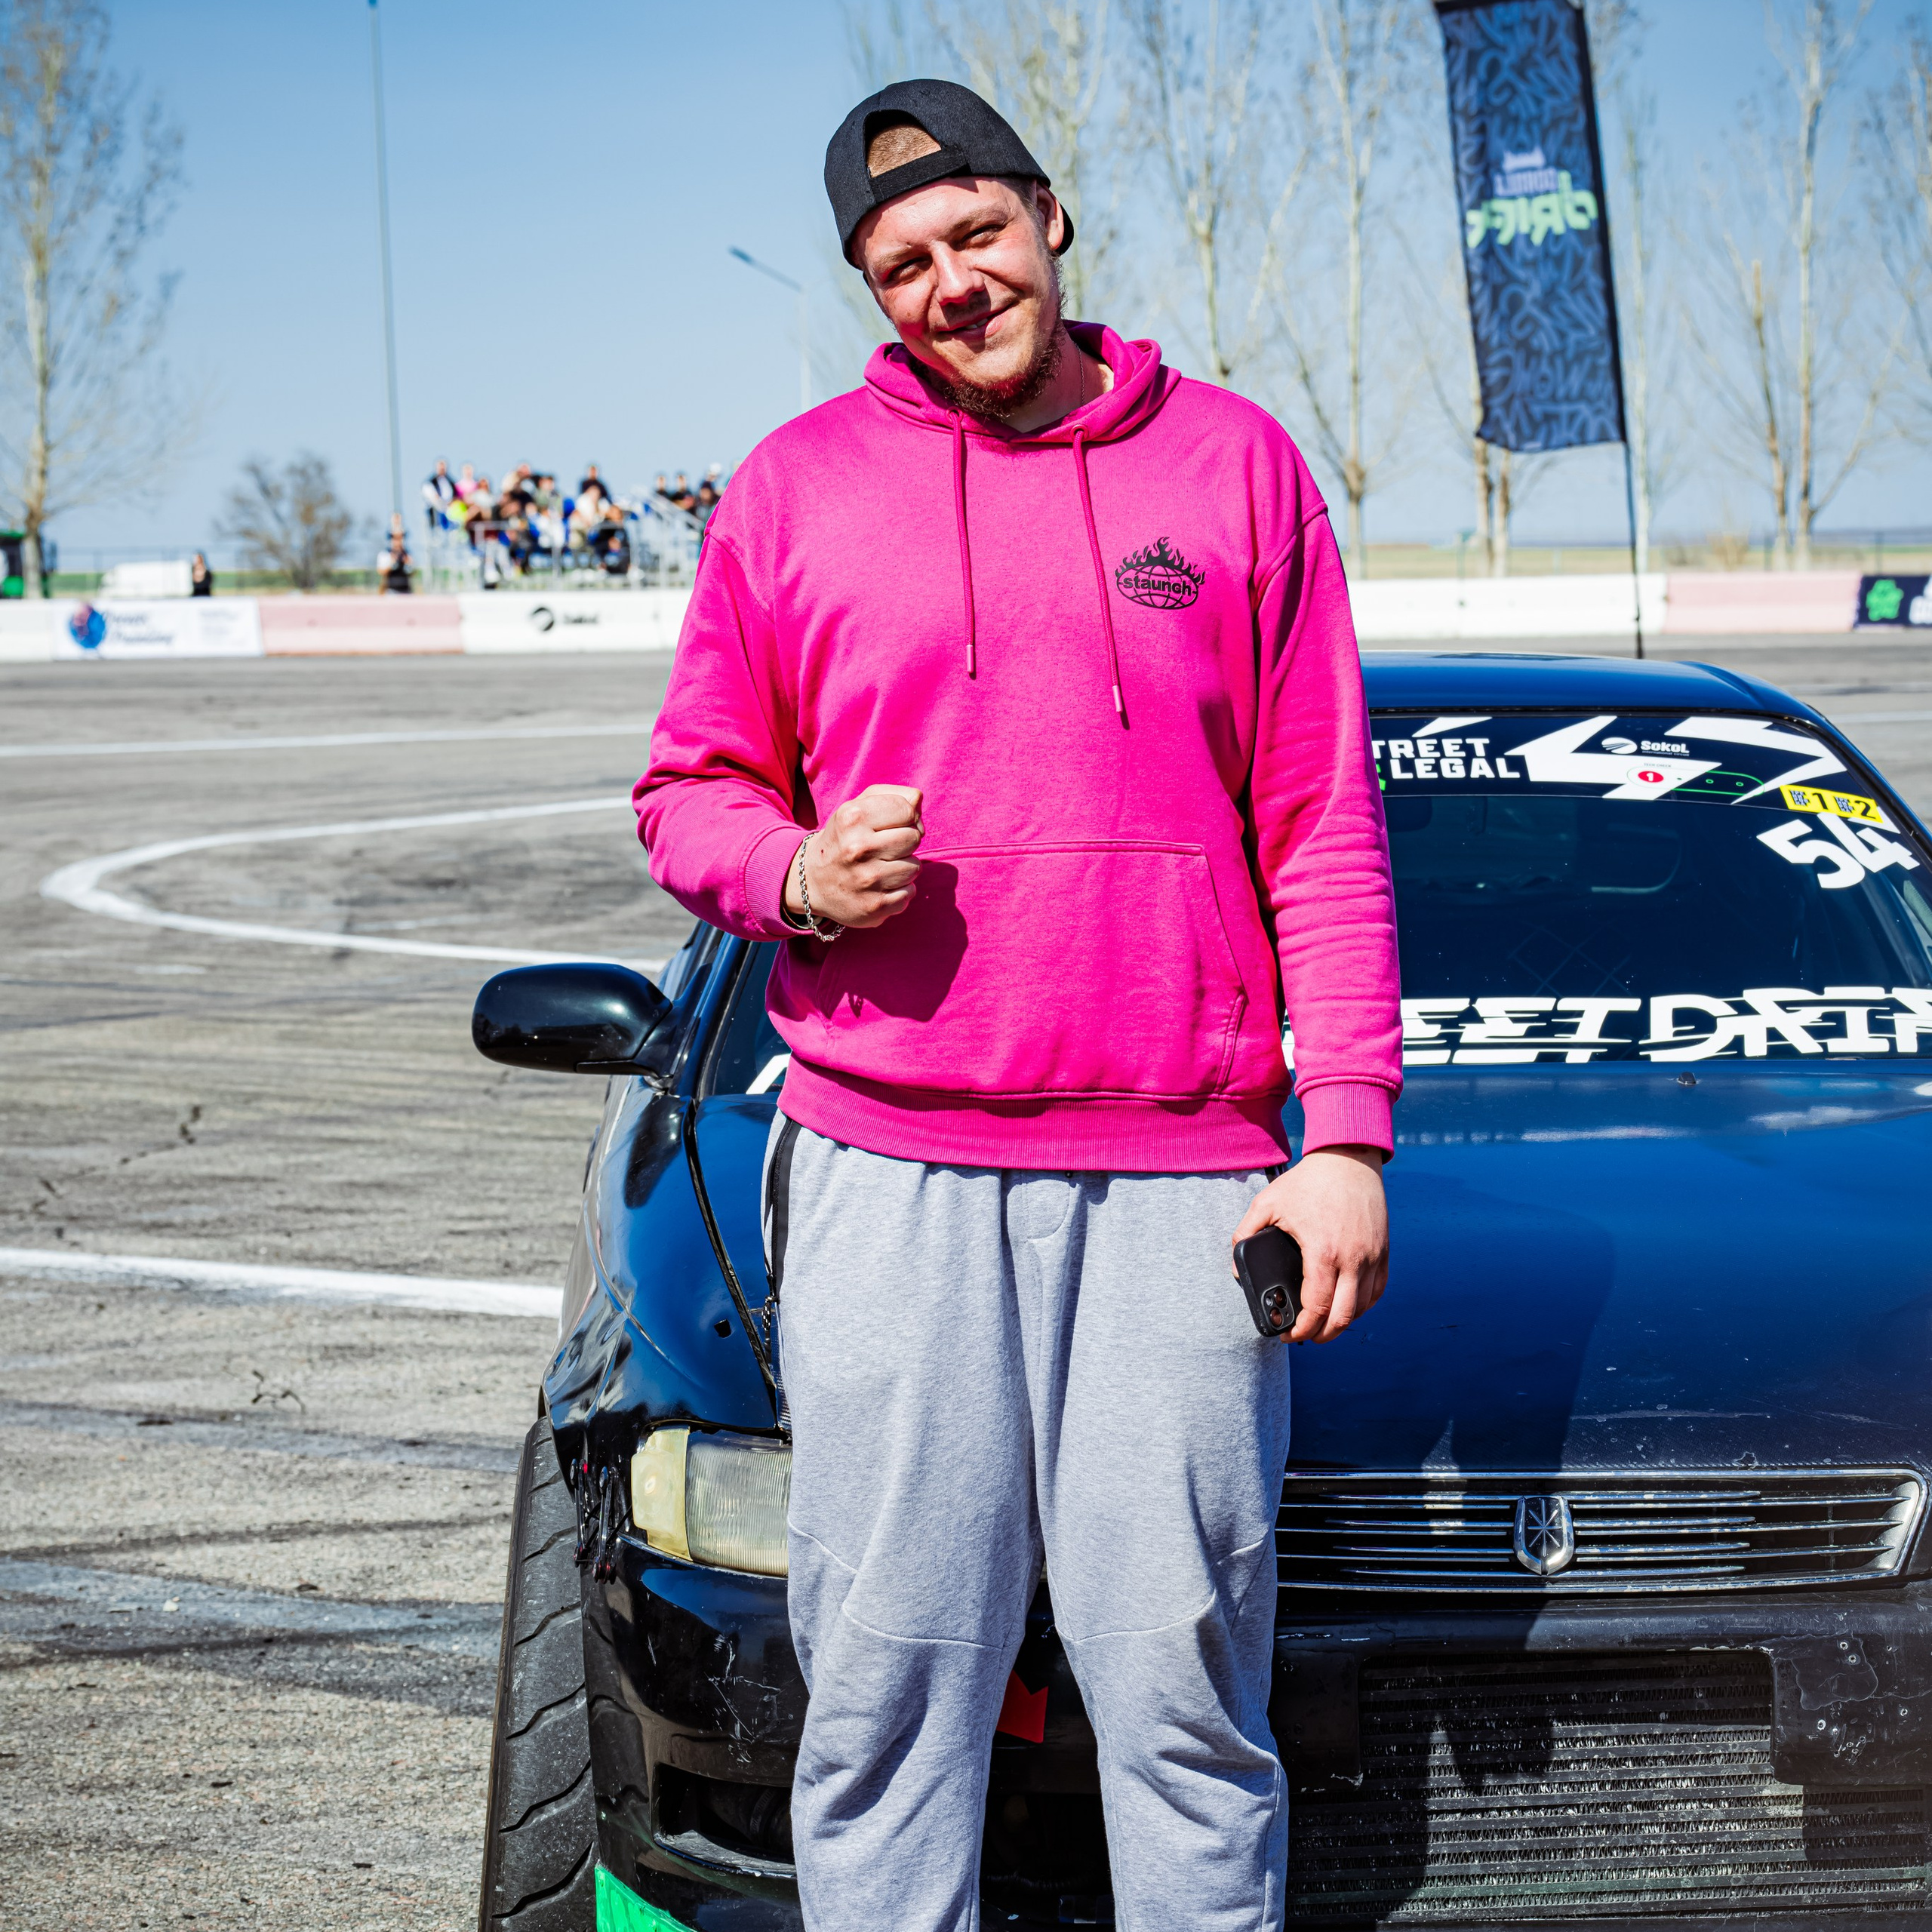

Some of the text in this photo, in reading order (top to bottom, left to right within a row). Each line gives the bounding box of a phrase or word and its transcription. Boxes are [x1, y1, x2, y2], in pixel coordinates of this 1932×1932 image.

[1123, 575, 1192, 596] staunch
[1390, 758, 1521, 779] LEGAL
[1646, 772, 1654, 782] 1
[1757, 812, 1921, 889] 54
